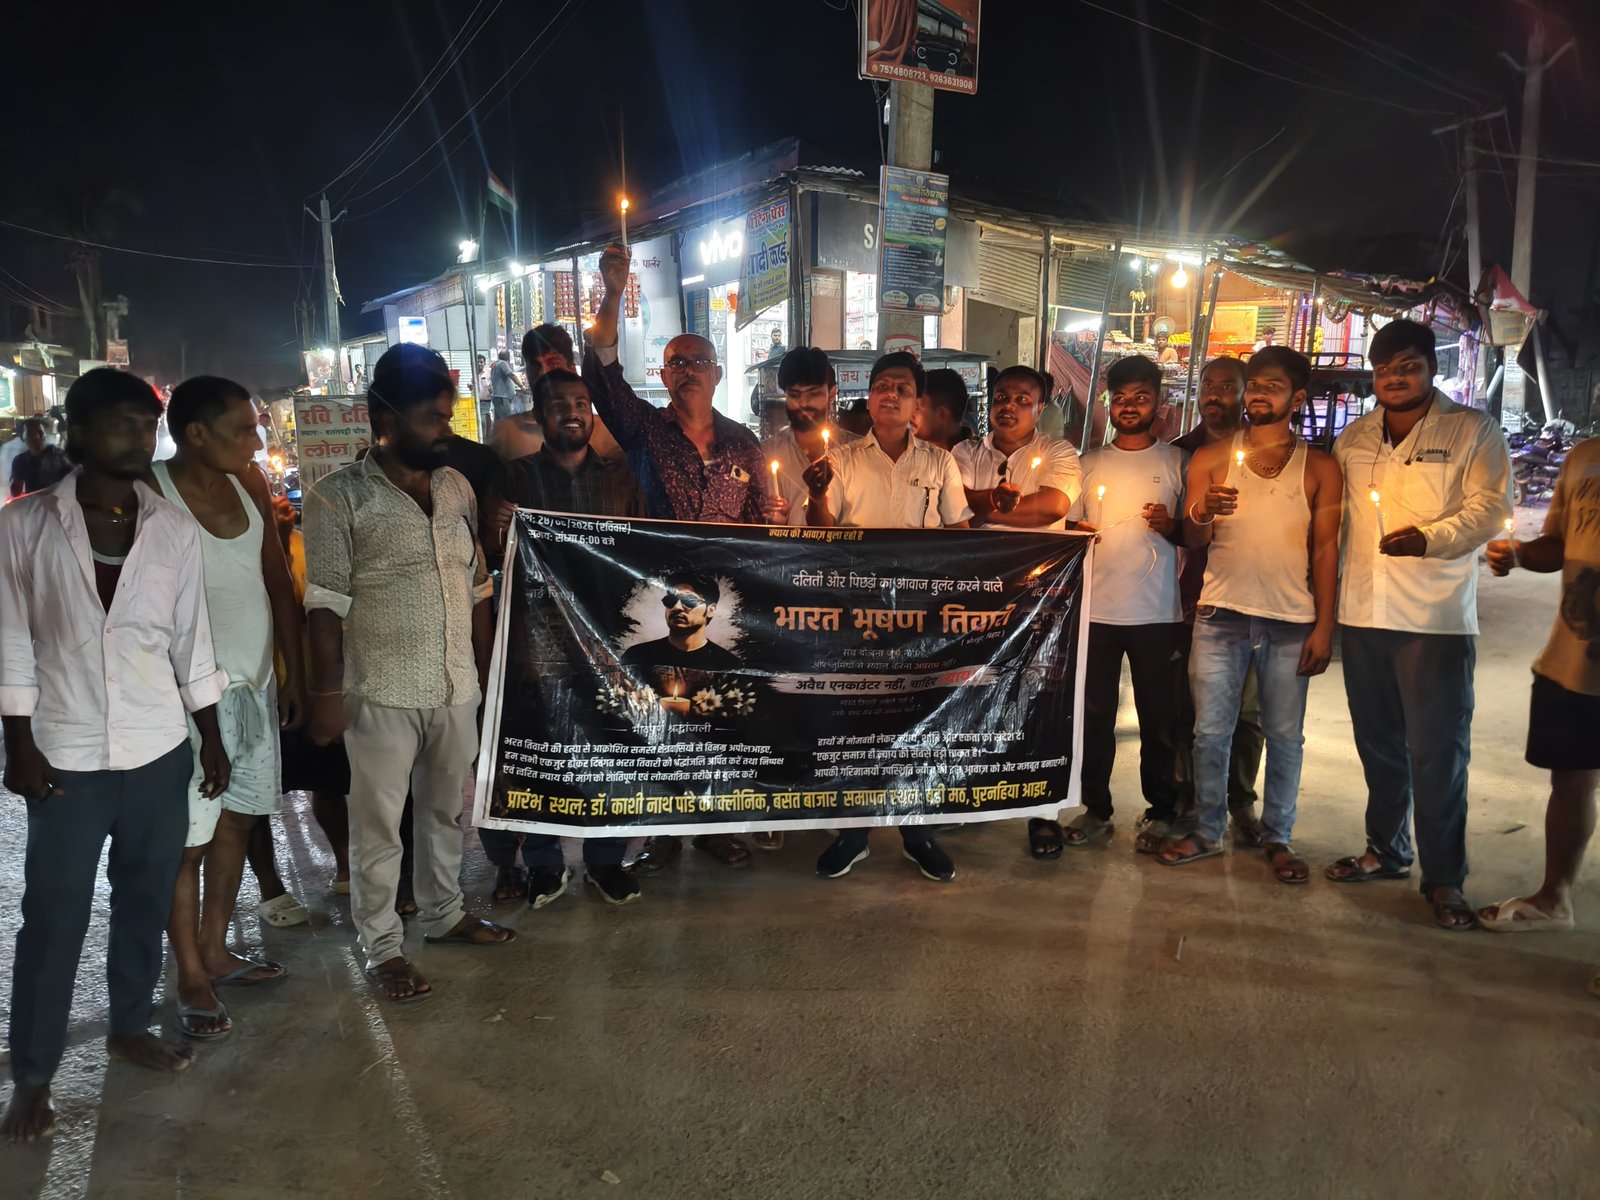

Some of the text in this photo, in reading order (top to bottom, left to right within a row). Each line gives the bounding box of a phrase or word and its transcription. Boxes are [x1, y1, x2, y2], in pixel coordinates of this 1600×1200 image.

[580, 535, 600, 545] 6:00
[601, 536, 615, 546] बजे
[769, 528, 789, 538] न्याय
[792, 569, 824, 588] दलितों
[826, 569, 846, 588] और
[849, 572, 876, 592] पिछड़ों
[931, 576, 954, 596] बुलंद
[956, 576, 980, 594] करने
[982, 576, 1003, 593] वाले
[774, 604, 843, 632] भारत
[852, 606, 927, 640] भूषण
[796, 676, 825, 691] अवैध
[829, 678, 882, 691] एनकाउंटर
[884, 676, 906, 691] नहीं,
[911, 676, 938, 690] चाहिए
[504, 736, 522, 748] भरत
[524, 738, 549, 753] तिवारी
[550, 742, 562, 754] की
[563, 745, 581, 754] हत्या
[582, 743, 590, 753] से
[592, 742, 628, 754] आक्रोशित
[696, 742, 703, 752] से
[818, 736, 836, 746] हाथों
[837, 735, 846, 745] में
[876, 732, 896, 744] लेकर
[504, 750, 518, 760] हम
[520, 753, 538, 764] सभी
[540, 758, 566, 770] एकजुट
[616, 758, 634, 768] भरत
[636, 756, 660, 768] तिवारी
[662, 757, 672, 767] को
[743, 757, 758, 766] तथा
[842, 750, 866, 760] समाज
[502, 763, 516, 774] एवं
[540, 772, 560, 782] न्याय
[562, 772, 574, 782] की
[576, 772, 592, 782] मांग
[594, 771, 604, 782] को
[638, 770, 650, 782] एवं
[814, 766, 838, 778] आपकी
[990, 762, 1000, 773] को
[1002, 760, 1016, 772] और
[1016, 760, 1040, 773] मजबूत
[507, 788, 544, 811] प्रारंभ
[549, 795, 586, 816] स्थल:
[590, 793, 608, 816] डॉ.
[610, 792, 644, 815] काशी
[646, 795, 674, 814] नाथ
[675, 790, 696, 814] पांडे
[716, 788, 771, 813] क्लीनिक,
[772, 788, 801, 809] बसंत
[802, 790, 838, 809] बाजार
[842, 789, 888, 807] समापन
[972, 780, 1020, 808] पुरनहिया
